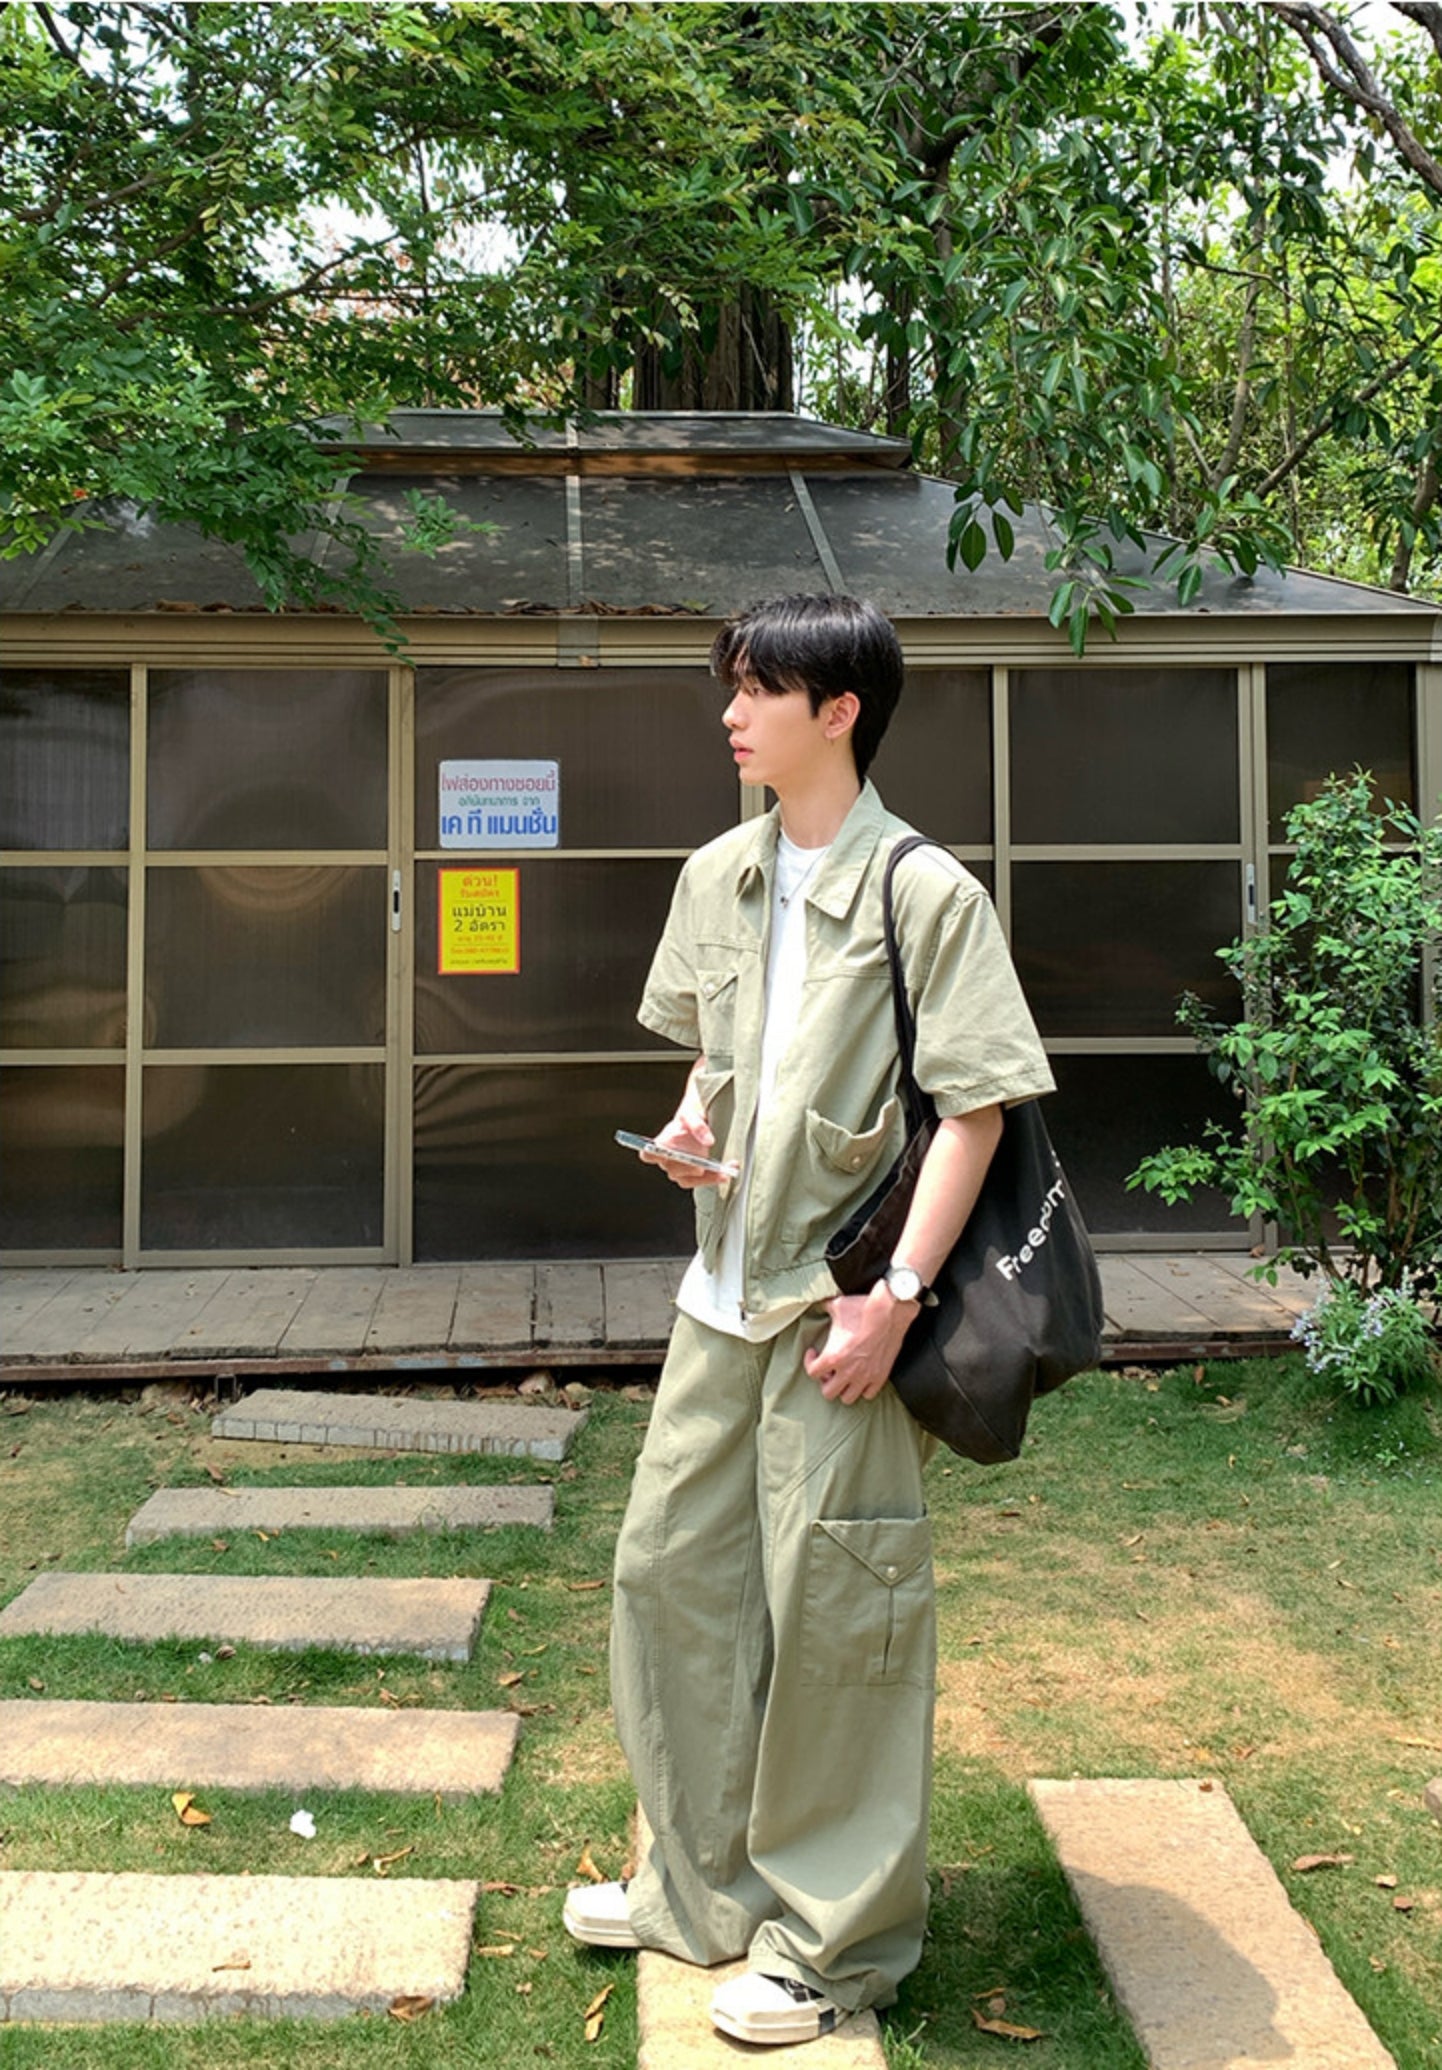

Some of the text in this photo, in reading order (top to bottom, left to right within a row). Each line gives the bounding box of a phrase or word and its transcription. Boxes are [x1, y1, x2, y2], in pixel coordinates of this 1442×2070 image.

[441, 807, 557, 835] เค ที แมนชั่น
[452, 903, 507, 917] แม่บ้าน
[453, 918, 506, 932] 2 อัตรา
